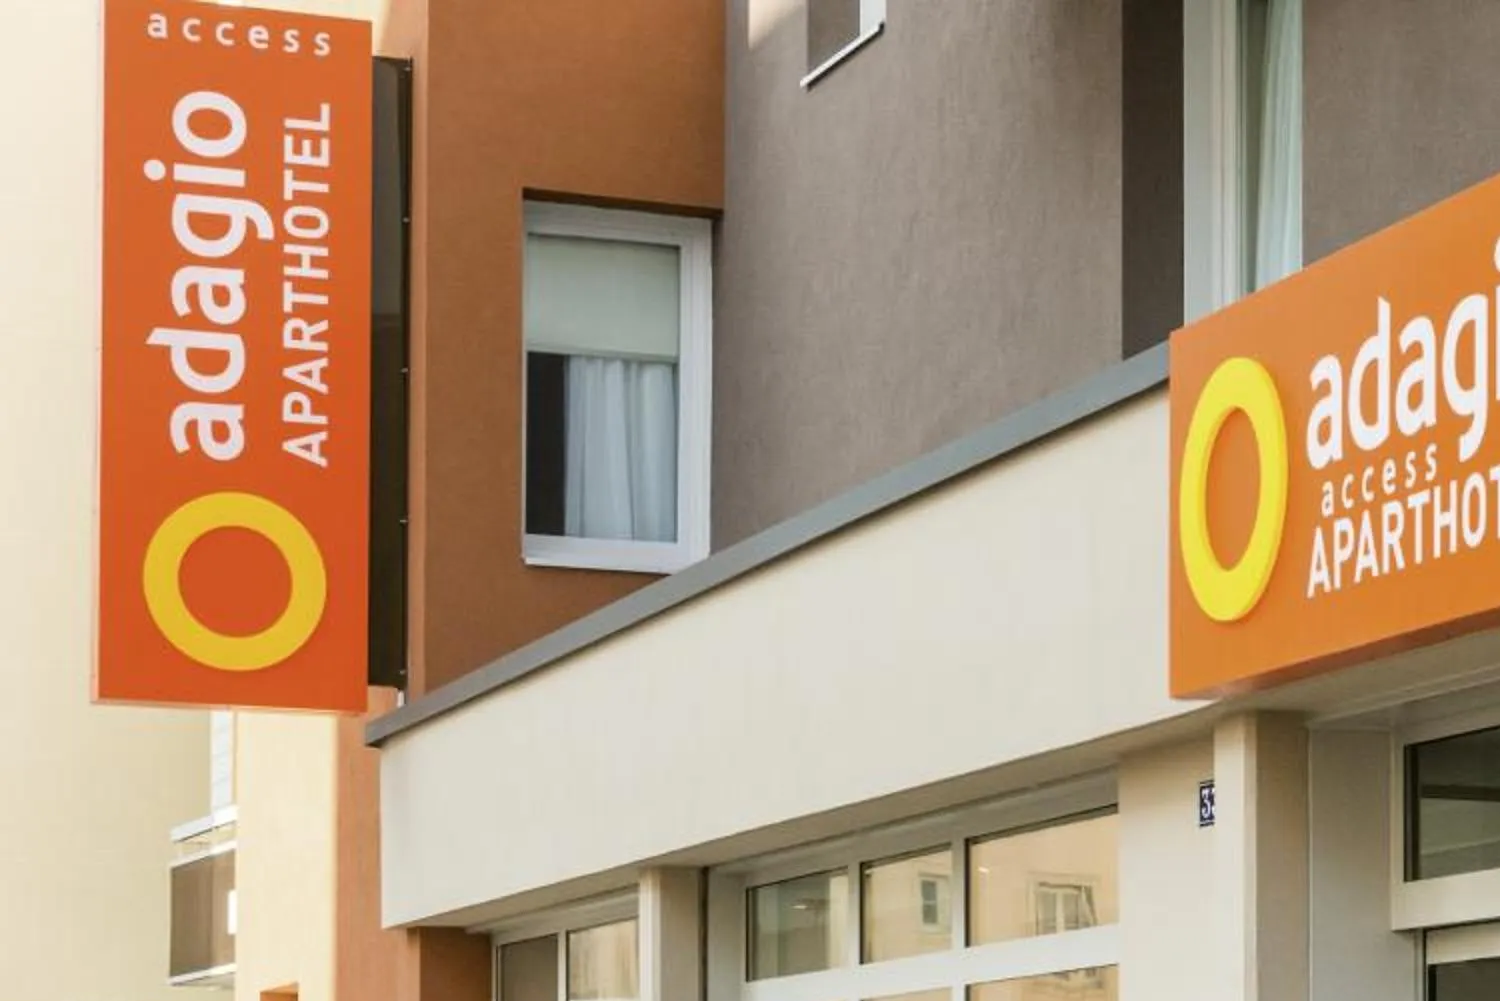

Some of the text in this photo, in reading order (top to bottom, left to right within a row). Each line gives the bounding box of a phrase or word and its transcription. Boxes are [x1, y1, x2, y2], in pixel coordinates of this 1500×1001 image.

[147, 13, 330, 56] access
[143, 90, 275, 461] adagio
[282, 103, 331, 467] APARTHOTEL
[1321, 443, 1437, 517] access
